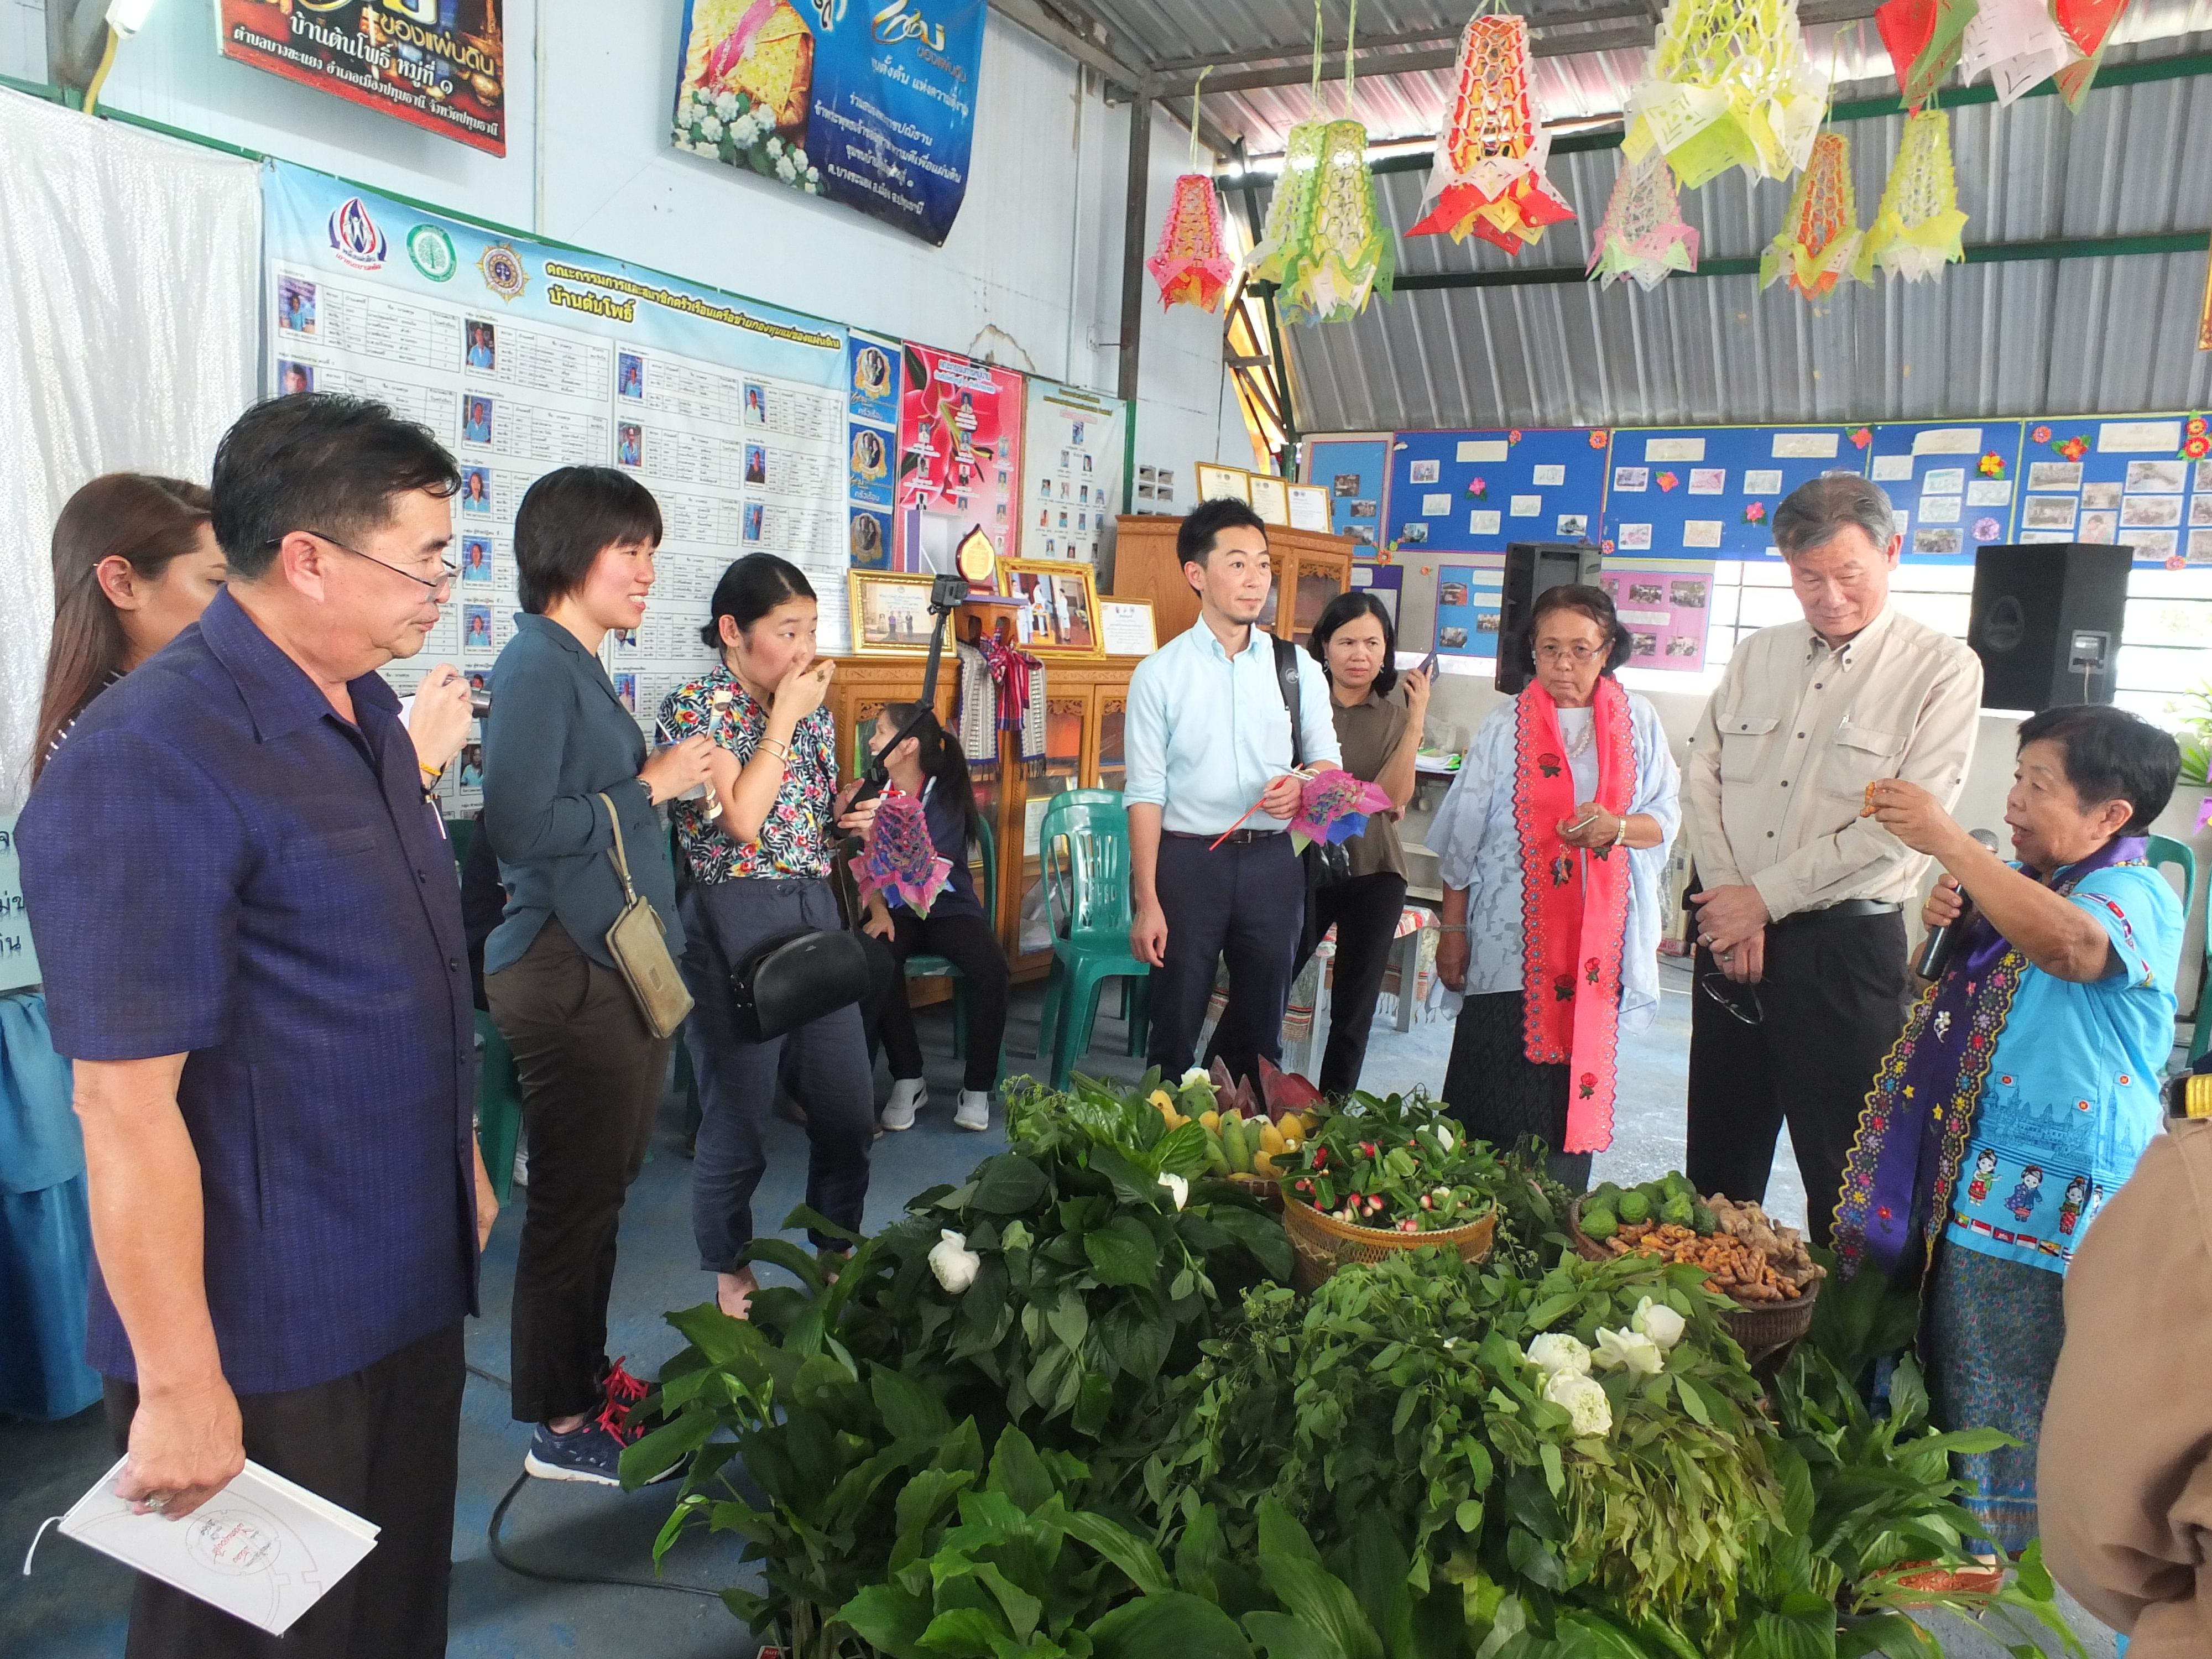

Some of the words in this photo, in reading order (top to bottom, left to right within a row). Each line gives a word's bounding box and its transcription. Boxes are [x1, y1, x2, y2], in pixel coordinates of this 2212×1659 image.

[290, 11, 393, 69] บ้านต้นโพธิ์
[397, 60, 436, 88] หมู่ที่
[440, 80, 453, 95] ๑
[380, 13, 494, 76] ของแผ่นดิน
[548, 284, 637, 322] บ้านต้นโพธิ์
